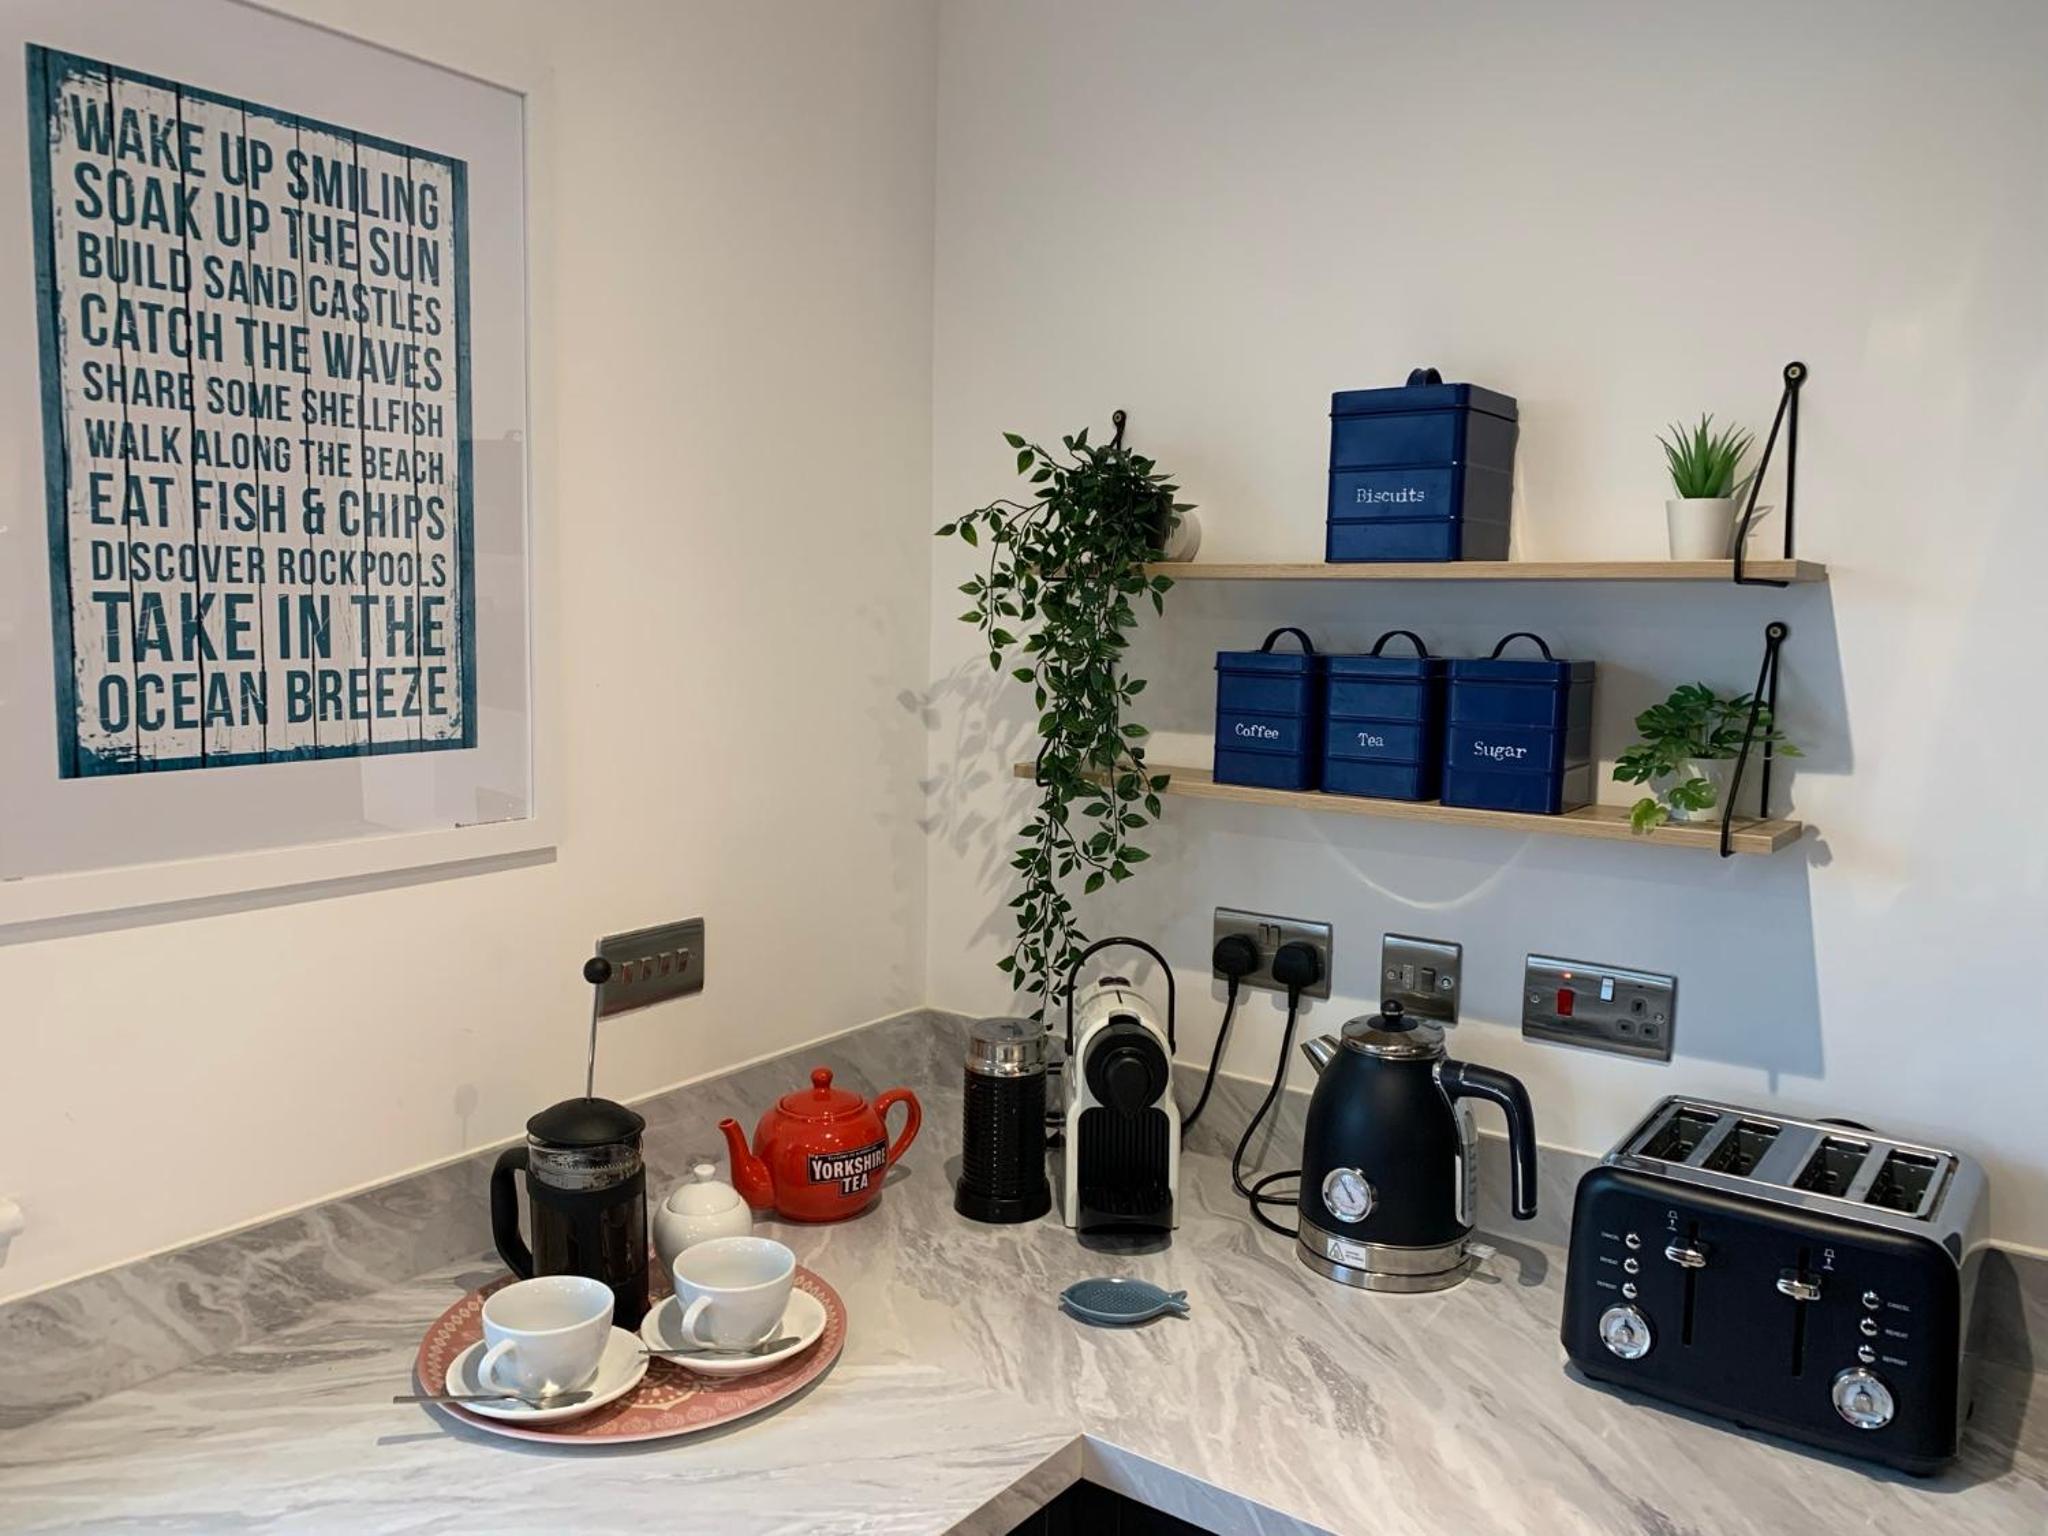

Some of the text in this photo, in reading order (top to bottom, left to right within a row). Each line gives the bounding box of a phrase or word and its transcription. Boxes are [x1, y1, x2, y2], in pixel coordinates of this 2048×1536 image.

[70, 93, 438, 230] WAKE UP SMILING
[75, 162, 439, 287] SOAK UP THE SUN
[77, 232, 441, 336] BUILD SAND CASTLES
[80, 294, 442, 392] CATCH THE WAVES
[83, 361, 443, 438] SHARE SOME SHELLFISH
[85, 418, 444, 485] WALK ALONG THE BEACH
[89, 472, 445, 541] EAT FISH & CHIPS
[1356, 487, 1426, 503] Biscuits
[91, 540, 446, 588] DISCOVER ROCKPOOLS
[92, 592, 446, 663] TAKE IN THE
[99, 665, 448, 733] OCEAN BREEZE
[1235, 723, 1279, 740] Coffee
[1358, 732, 1384, 747] Tea
[1473, 741, 1527, 760] Sugar
[811, 1147, 886, 1180] YORKSHIRE
[843, 1173, 868, 1193] TEA
